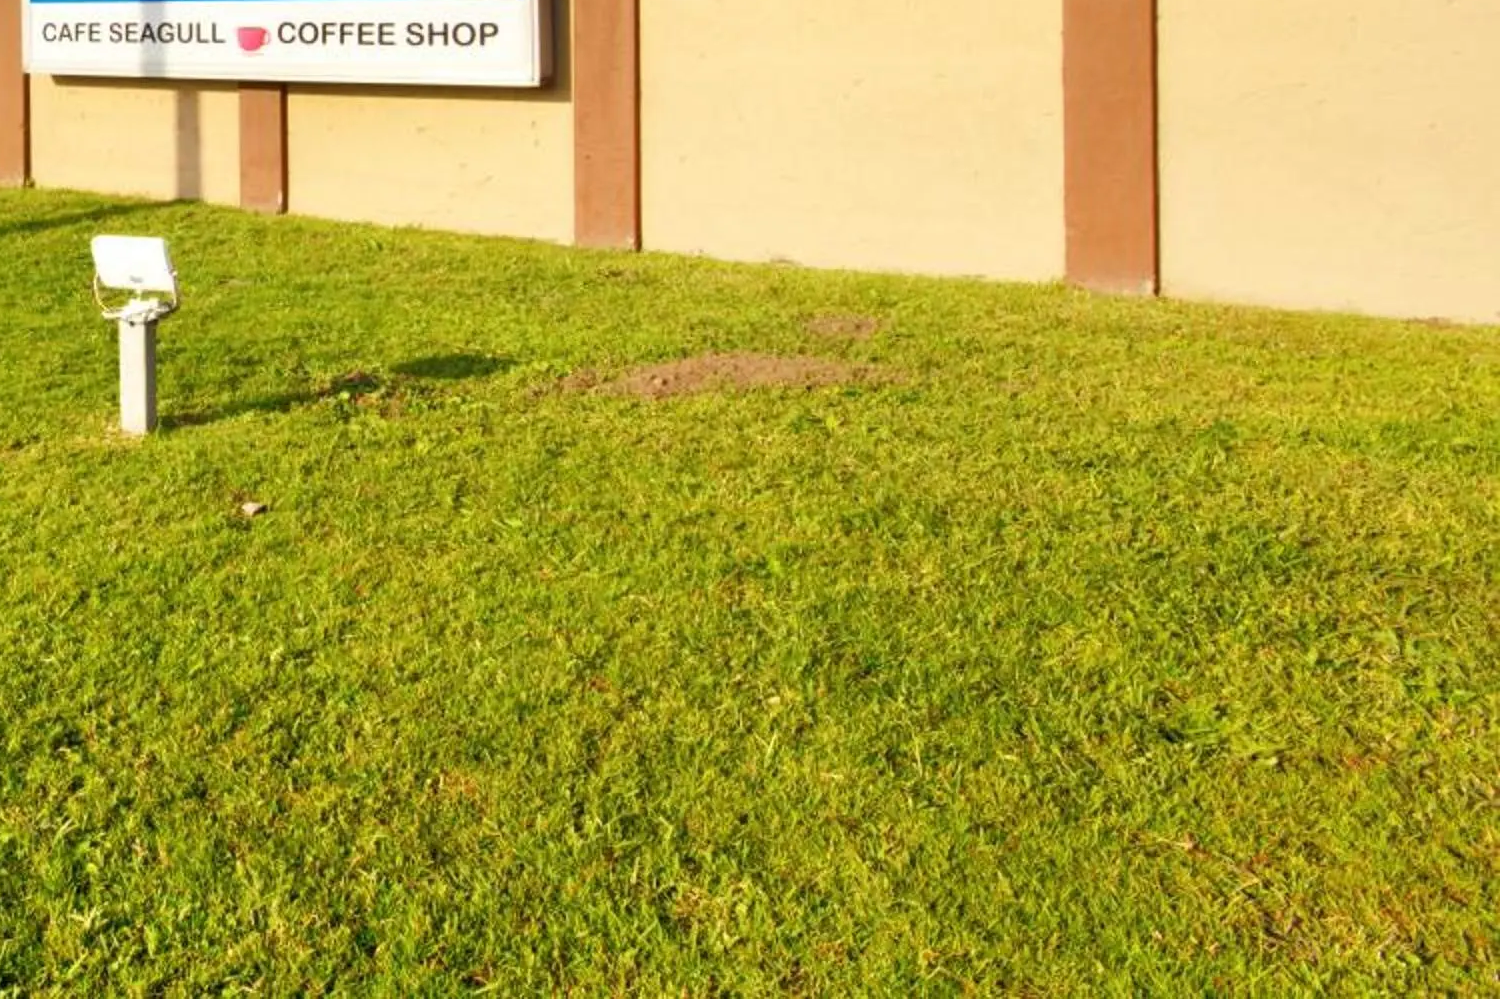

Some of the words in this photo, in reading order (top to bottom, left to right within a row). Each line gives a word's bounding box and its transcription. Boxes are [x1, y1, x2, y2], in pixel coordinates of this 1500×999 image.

[42, 22, 101, 43] CAFE
[109, 22, 226, 44] SEAGULL
[277, 21, 396, 46] COFFEE
[406, 22, 499, 47] SHOP
